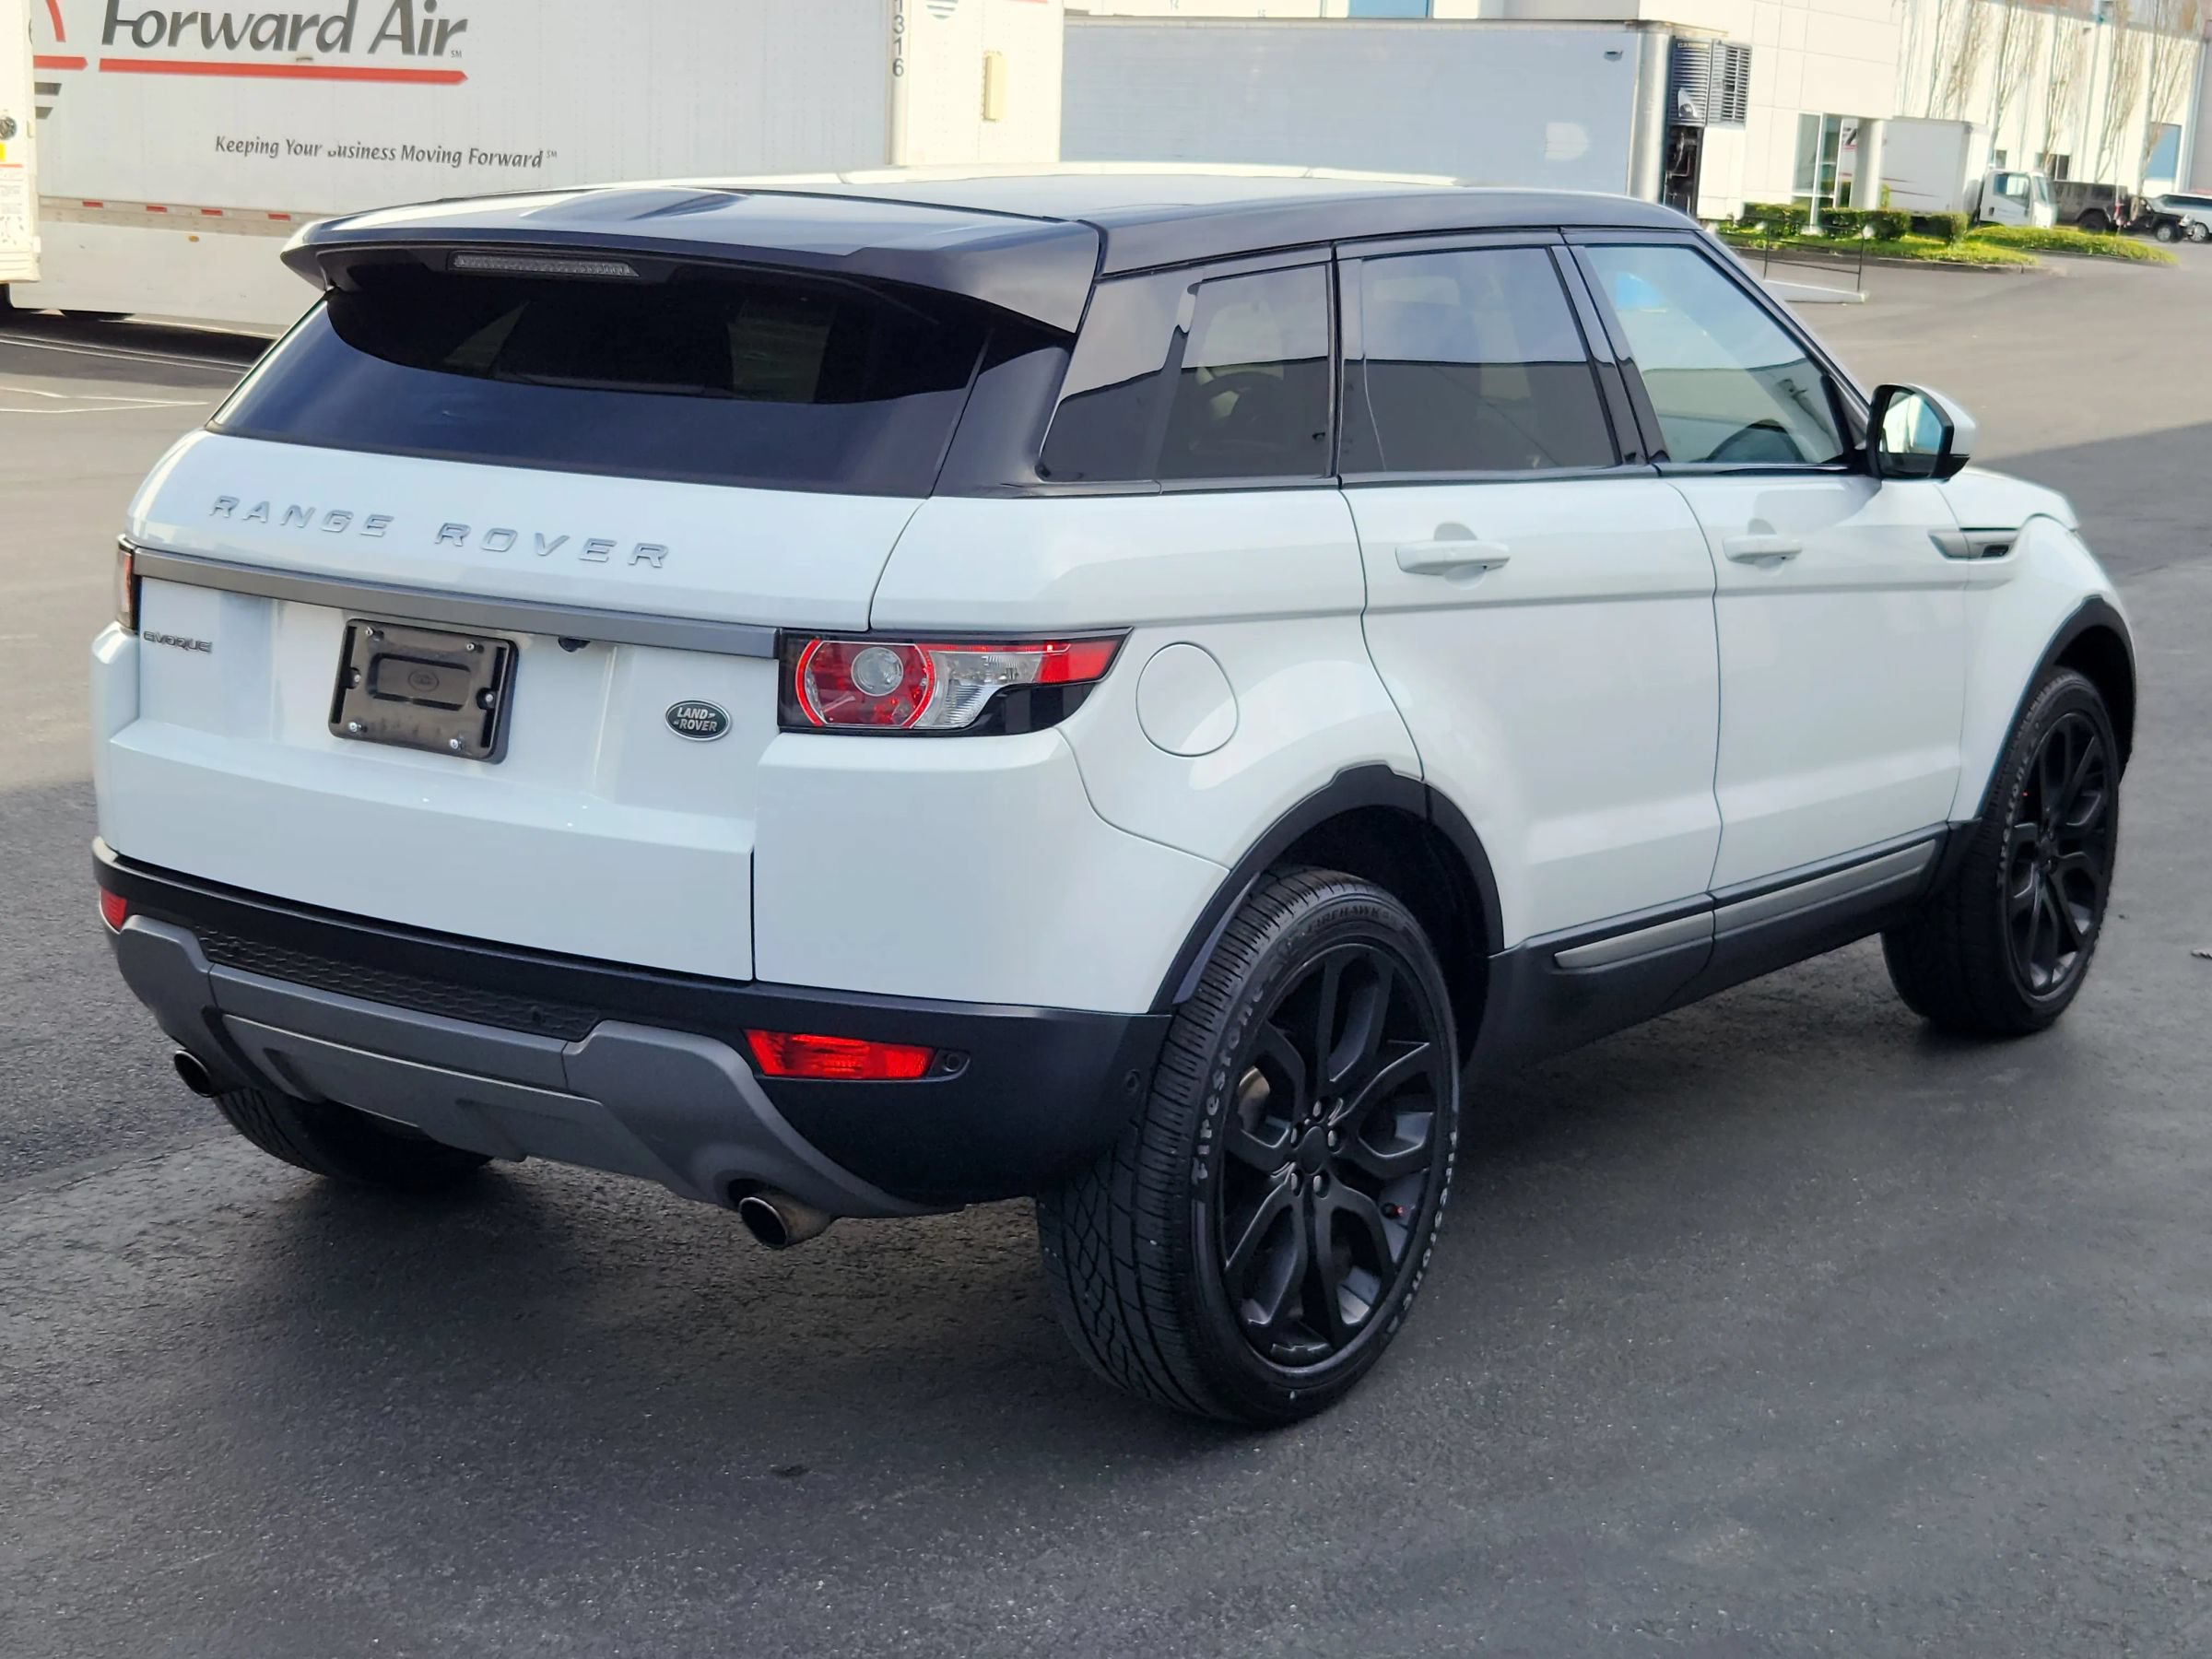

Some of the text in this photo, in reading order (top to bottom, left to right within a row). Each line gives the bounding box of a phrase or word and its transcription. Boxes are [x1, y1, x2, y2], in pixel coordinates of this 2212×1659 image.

[101, 0, 467, 57] Forward Air
[216, 135, 279, 159] Keeping
[286, 138, 323, 157] Your
[401, 145, 463, 169] Moving
[468, 147, 544, 168] Forward
[209, 495, 669, 568] RANGE ROVER
[143, 630, 213, 653] EVOQUE
[677, 707, 708, 719] LAND
[679, 719, 717, 731] ROVER
